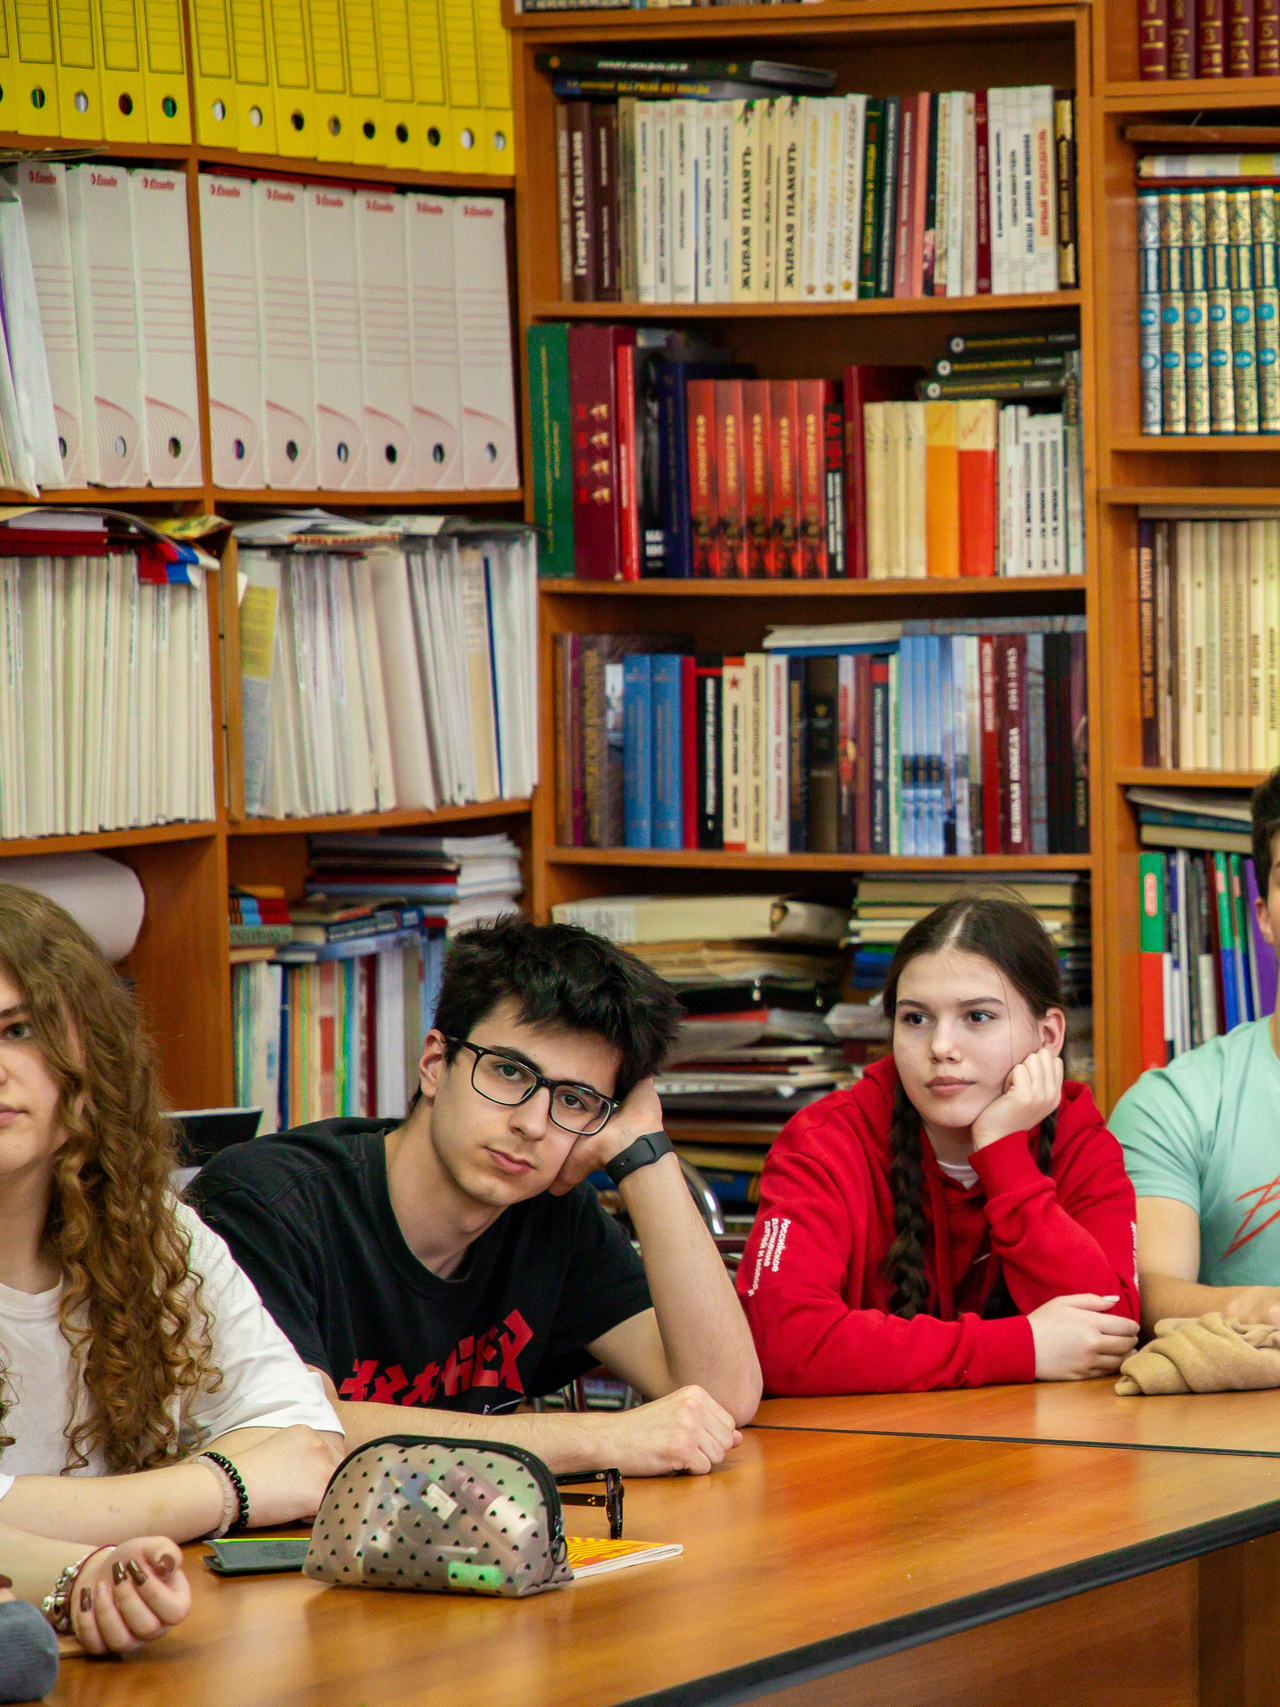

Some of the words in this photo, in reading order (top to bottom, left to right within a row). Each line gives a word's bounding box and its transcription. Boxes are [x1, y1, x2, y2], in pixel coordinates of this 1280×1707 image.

[1262, 22, 1273, 38] 5
[742, 146, 752, 220] ПАМЯТЬ
[786, 142, 797, 217] ПАМЯТЬ
[1037, 129, 1048, 196] ПРЕДСЕДАТЕЛЬ
[1038, 200, 1049, 236] ПЕРВЫЙ
[741, 226, 751, 290] ЖИВАЯ
[785, 223, 796, 288] ЖИВАЯ
[1007, 648, 1019, 710] 1941-1945
[760, 1221, 771, 1249] детей
[763, 1218, 779, 1267] движение
[772, 1218, 791, 1272] Российское
